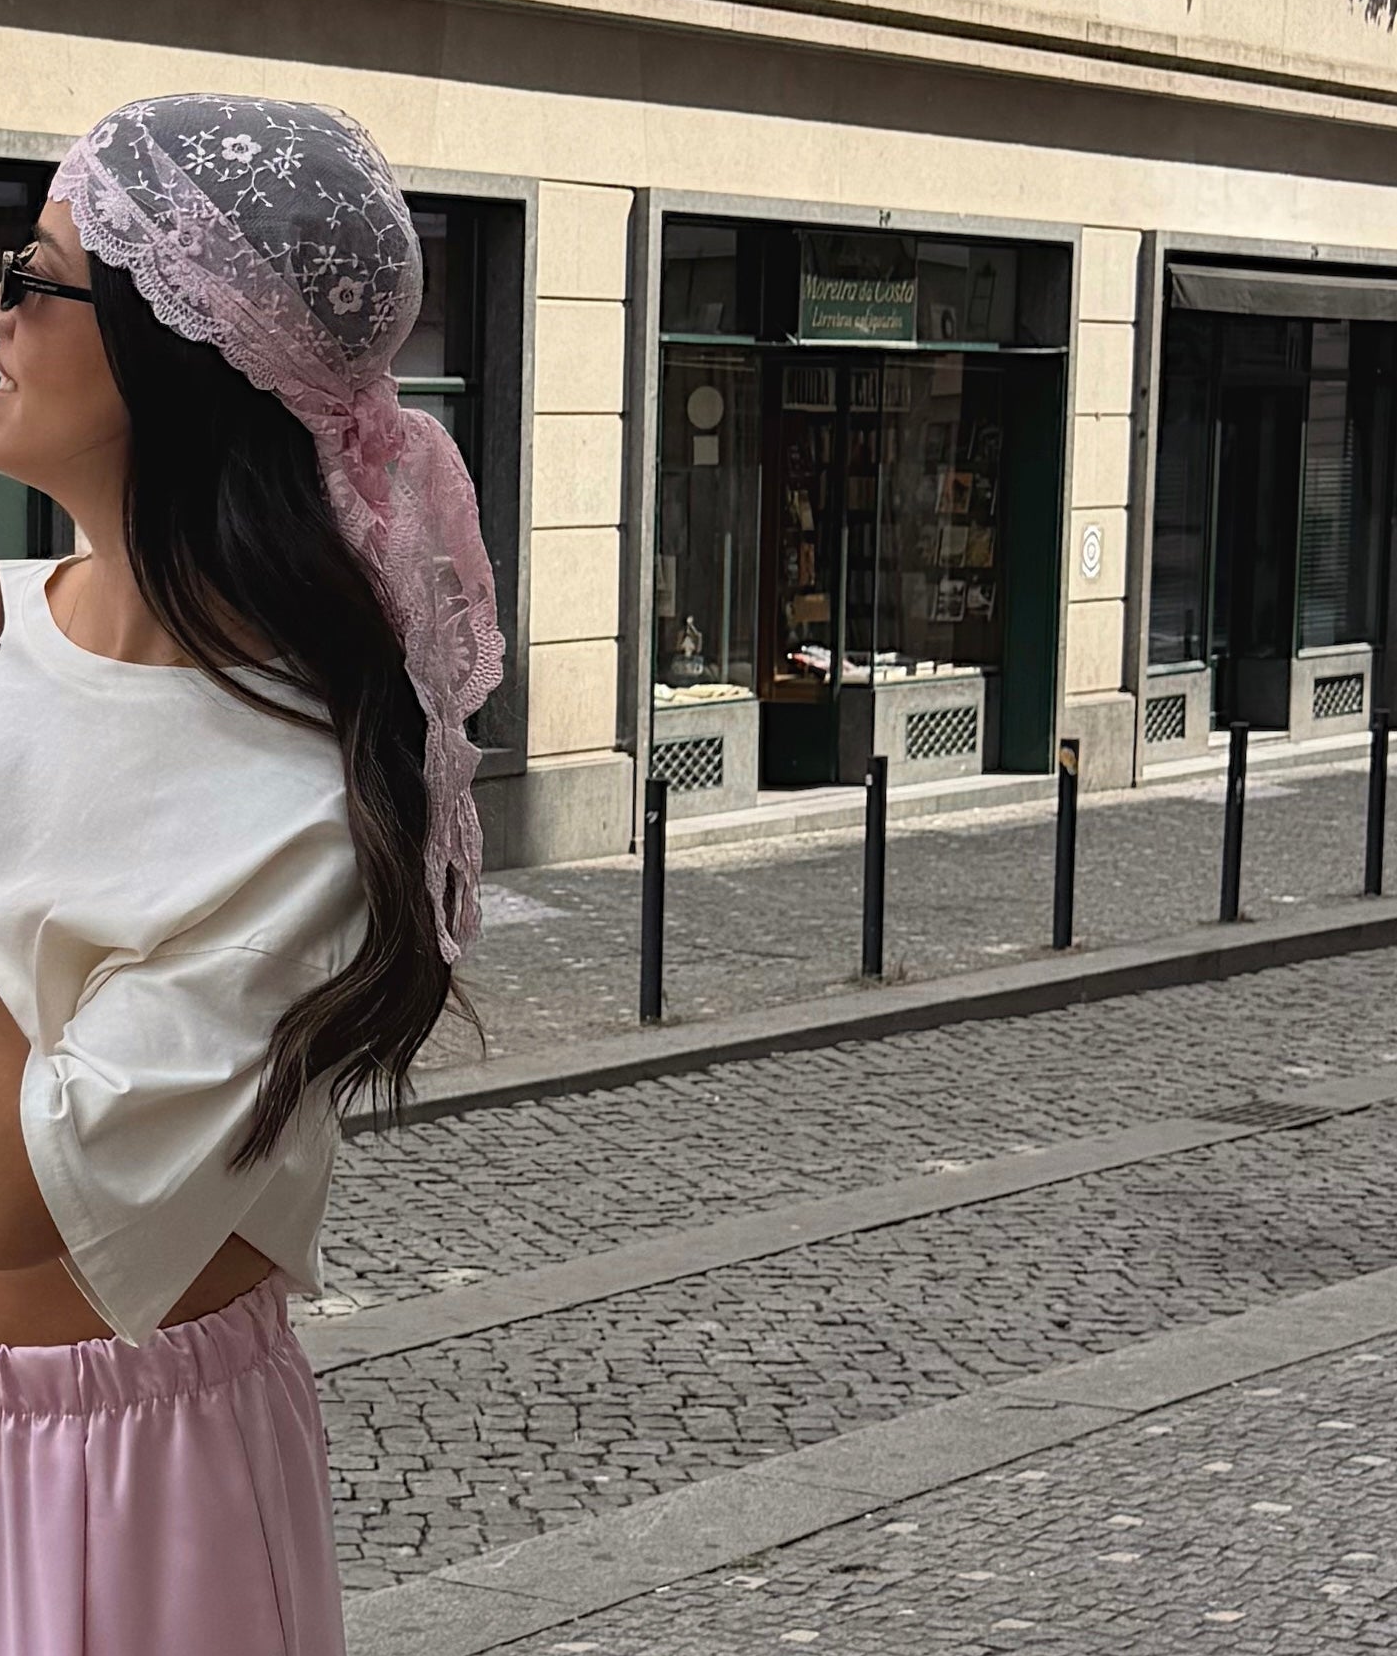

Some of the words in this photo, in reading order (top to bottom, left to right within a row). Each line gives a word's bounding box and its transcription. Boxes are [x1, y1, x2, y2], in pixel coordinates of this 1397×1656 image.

[804, 274, 858, 301] Moreira
[858, 280, 873, 301] da
[874, 280, 915, 303] Costa
